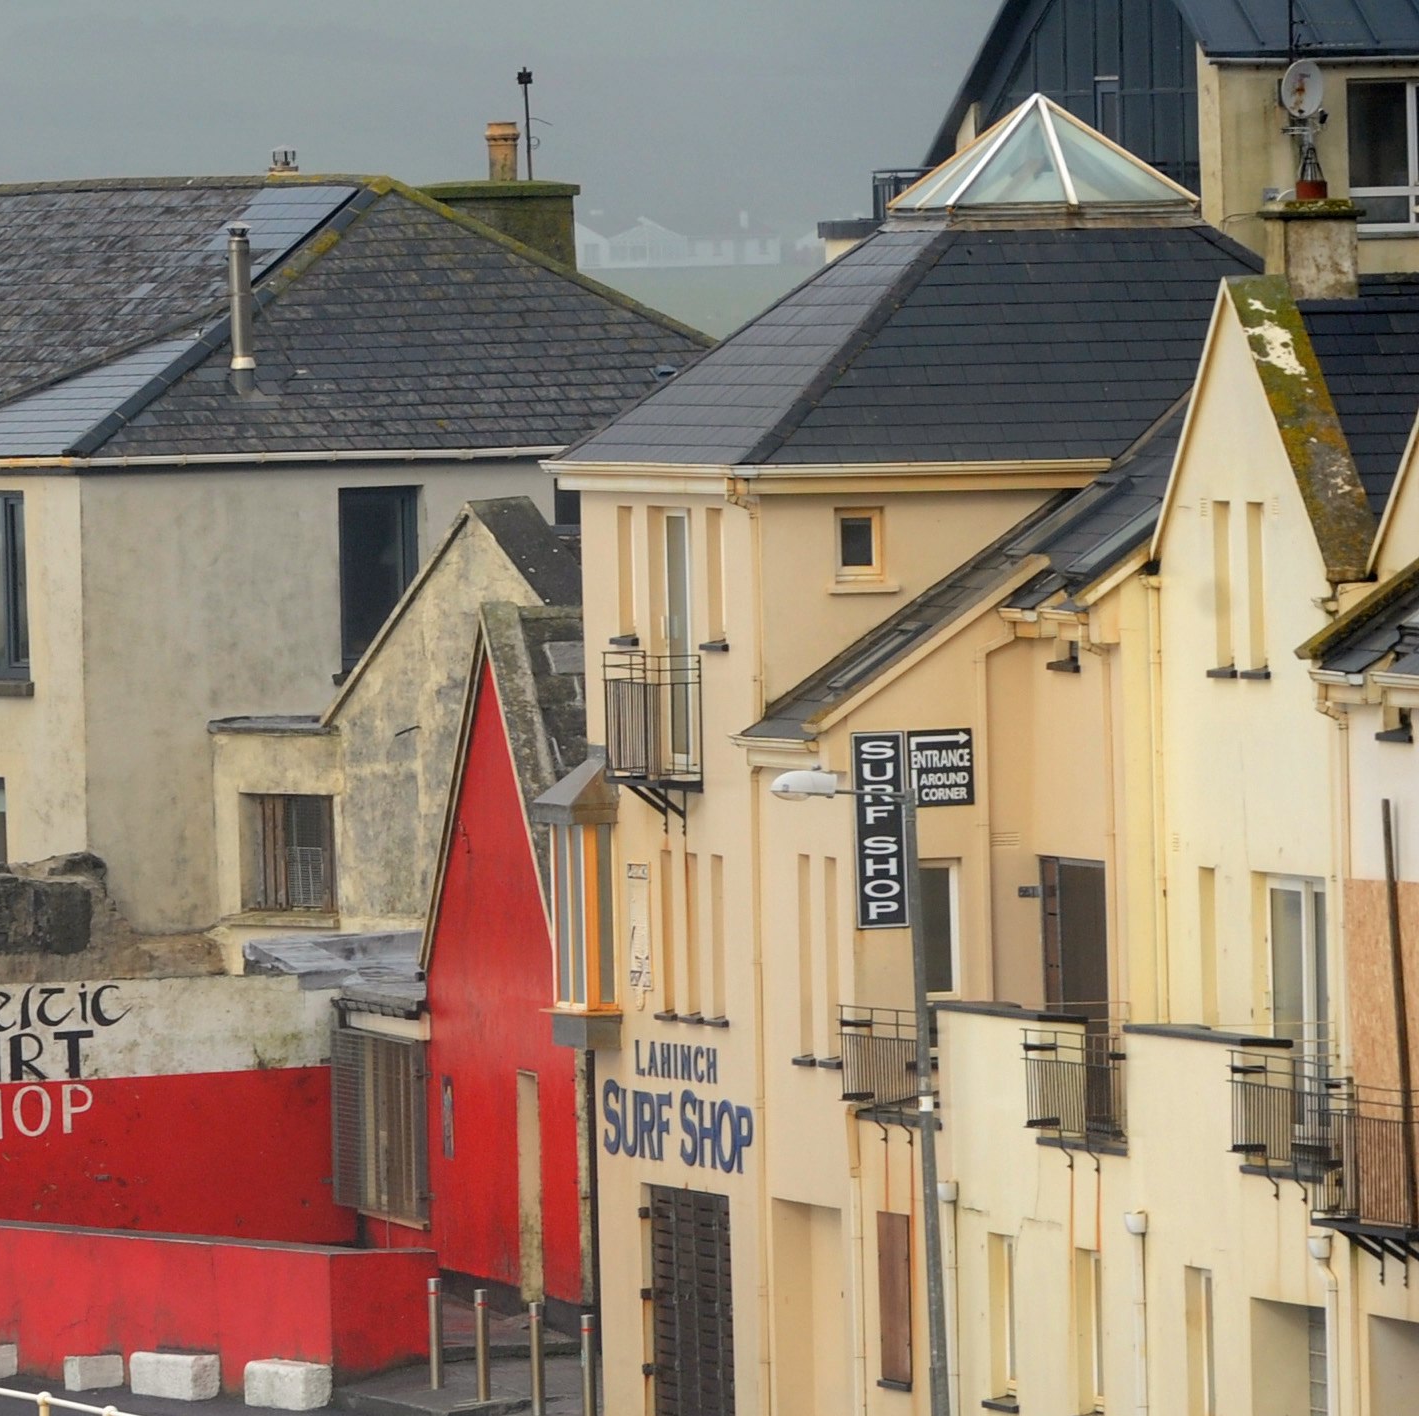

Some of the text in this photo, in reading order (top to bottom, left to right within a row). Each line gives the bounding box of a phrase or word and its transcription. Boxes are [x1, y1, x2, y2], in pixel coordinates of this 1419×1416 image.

[911, 748, 971, 768] ENTRANCE
[920, 771, 970, 786] AROUND
[921, 786, 968, 801] CORNER
[860, 740, 901, 920] SURF SHOP
[635, 1039, 718, 1085] LAHINCH
[603, 1078, 754, 1175] SURF SHOP
